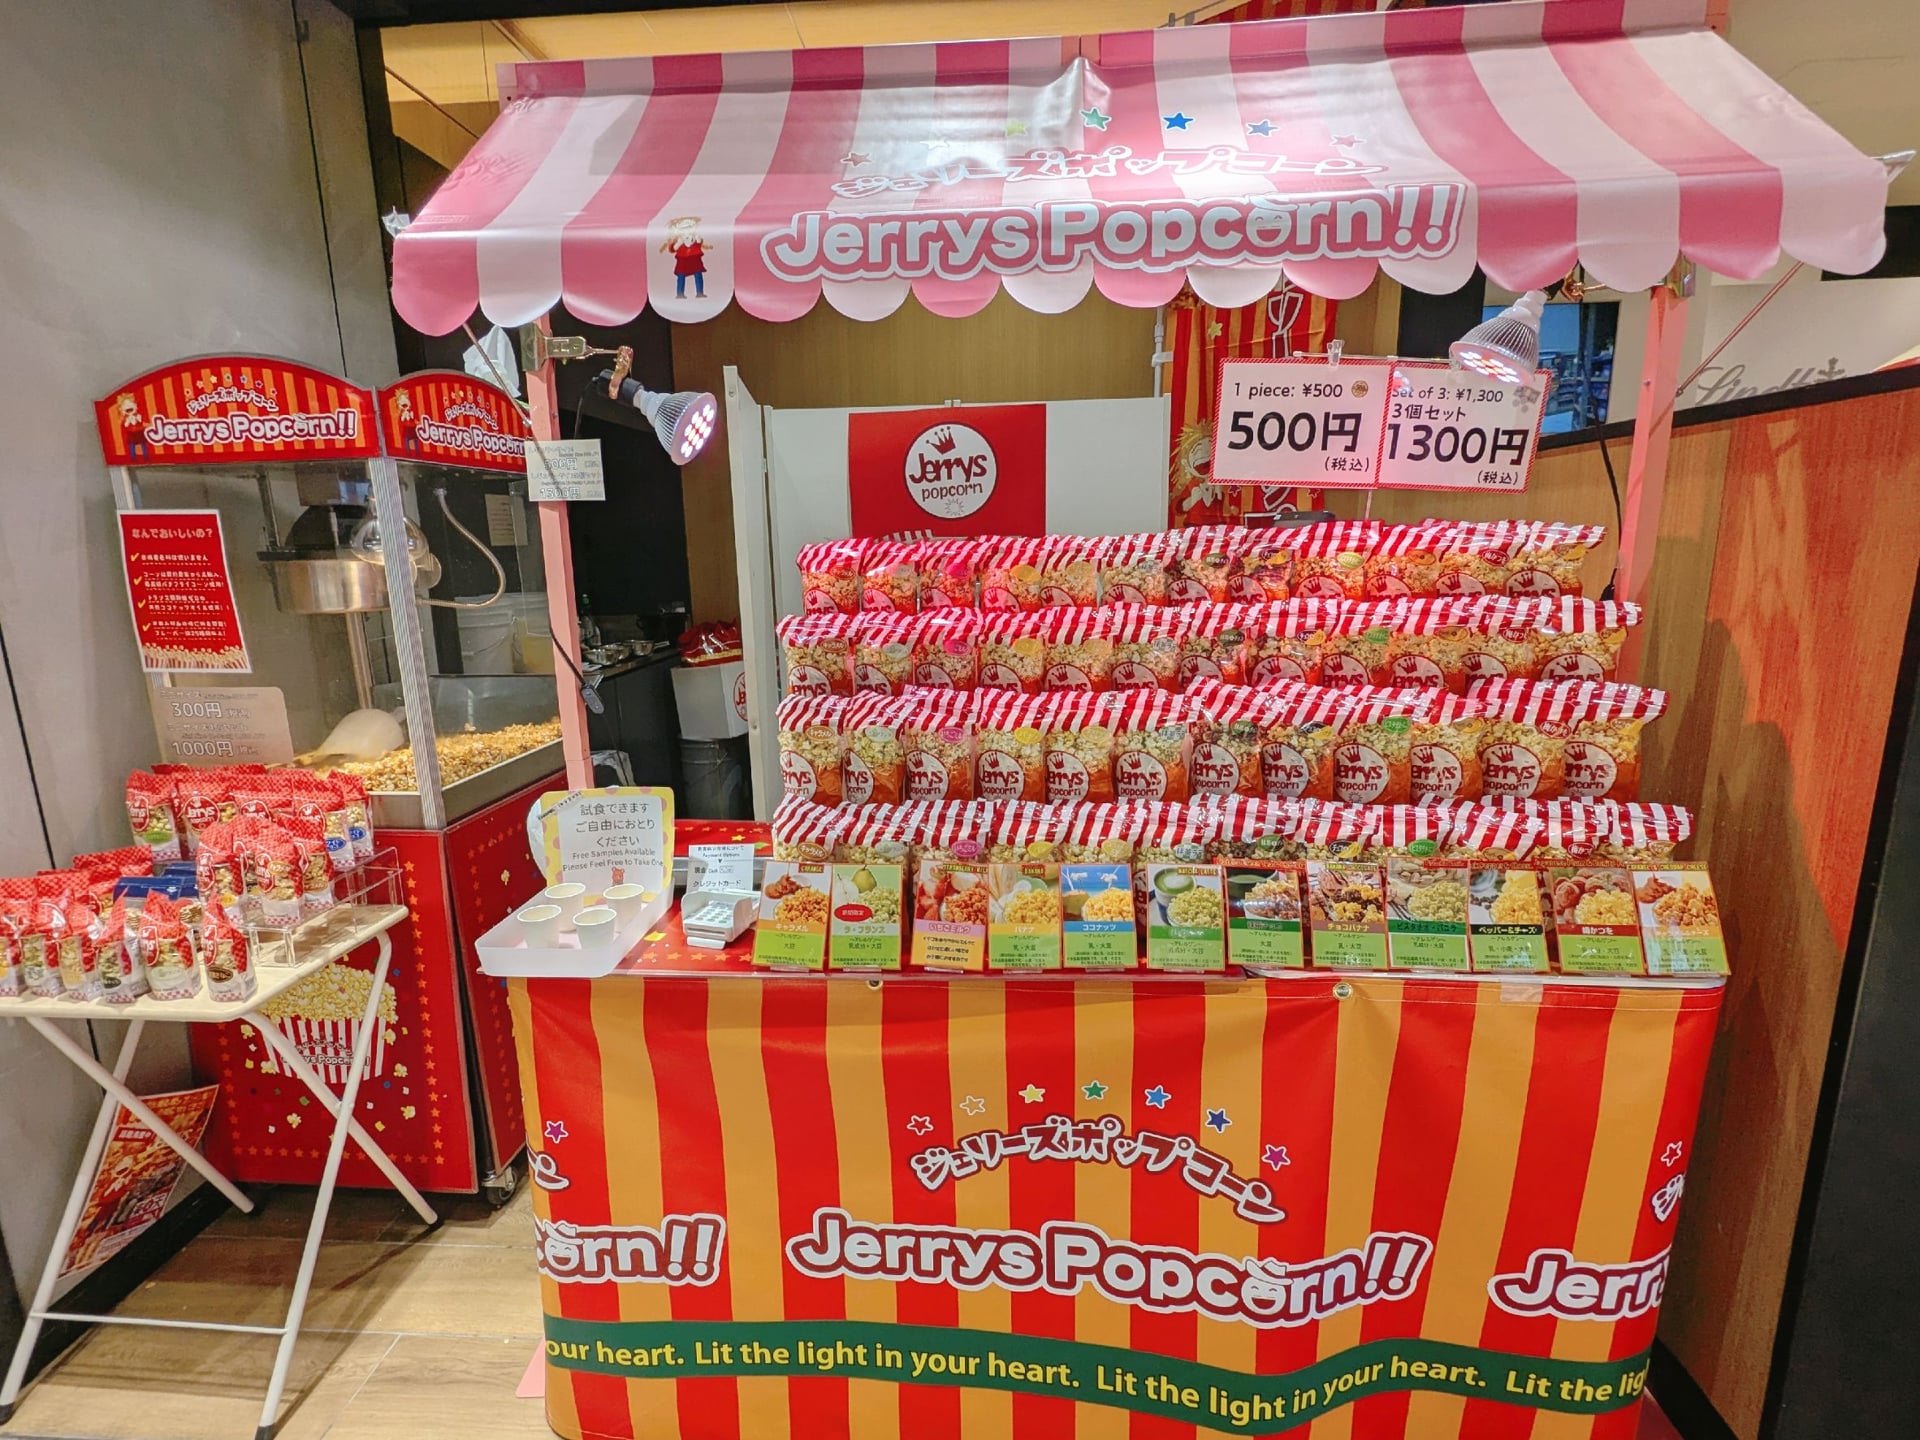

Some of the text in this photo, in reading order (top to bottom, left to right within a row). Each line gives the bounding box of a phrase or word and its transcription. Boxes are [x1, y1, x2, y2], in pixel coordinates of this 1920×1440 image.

[760, 206, 1033, 283] Jerrys
[1234, 382, 1343, 399] 1 piece: ¥500
[1392, 386, 1504, 403] Set of 3: ¥1,300
[1392, 403, 1467, 423] 3個セット
[144, 414, 231, 445] Jerrys
[416, 414, 472, 450] Jerrys
[1228, 410, 1363, 453] 500円
[1387, 423, 1530, 466] 1300円
[909, 453, 988, 484] Jerrys
[1324, 455, 1370, 473] (税込)
[1477, 470, 1519, 486] (税込)
[922, 481, 984, 502] popcorn
[171, 702, 222, 718] 300円
[172, 741, 234, 756] 1000円
[580, 802, 648, 816] 試食できます
[576, 819, 655, 833] ご自由におとり
[596, 836, 640, 847] ください
[572, 847, 656, 860] Free Samples Available
[563, 864, 588, 872] Please
[589, 860, 606, 869] Feel
[607, 859, 624, 867] Free
[624, 858, 632, 866] to
[1082, 923, 1117, 932] ココナッツ
[1327, 922, 1370, 932] チョコバナナ
[909, 1115, 1287, 1223] ジェリーズポップコーン
[786, 1208, 1043, 1292] Jerrys
[597, 1341, 684, 1367] heart.
[696, 1340, 732, 1365] Lit
[740, 1341, 790, 1366] the
[797, 1342, 868, 1372] light
[876, 1343, 904, 1370] in
[911, 1350, 981, 1378] your
[988, 1353, 1081, 1389] heart.
[1097, 1364, 1138, 1396] Lit
[1145, 1372, 1200, 1409] the
[1208, 1385, 1286, 1427] light
[1293, 1380, 1317, 1413] in
[1323, 1359, 1385, 1406] your
[1389, 1353, 1488, 1388] heart.
[1506, 1370, 1553, 1400] Lit
[1559, 1375, 1613, 1405] the
